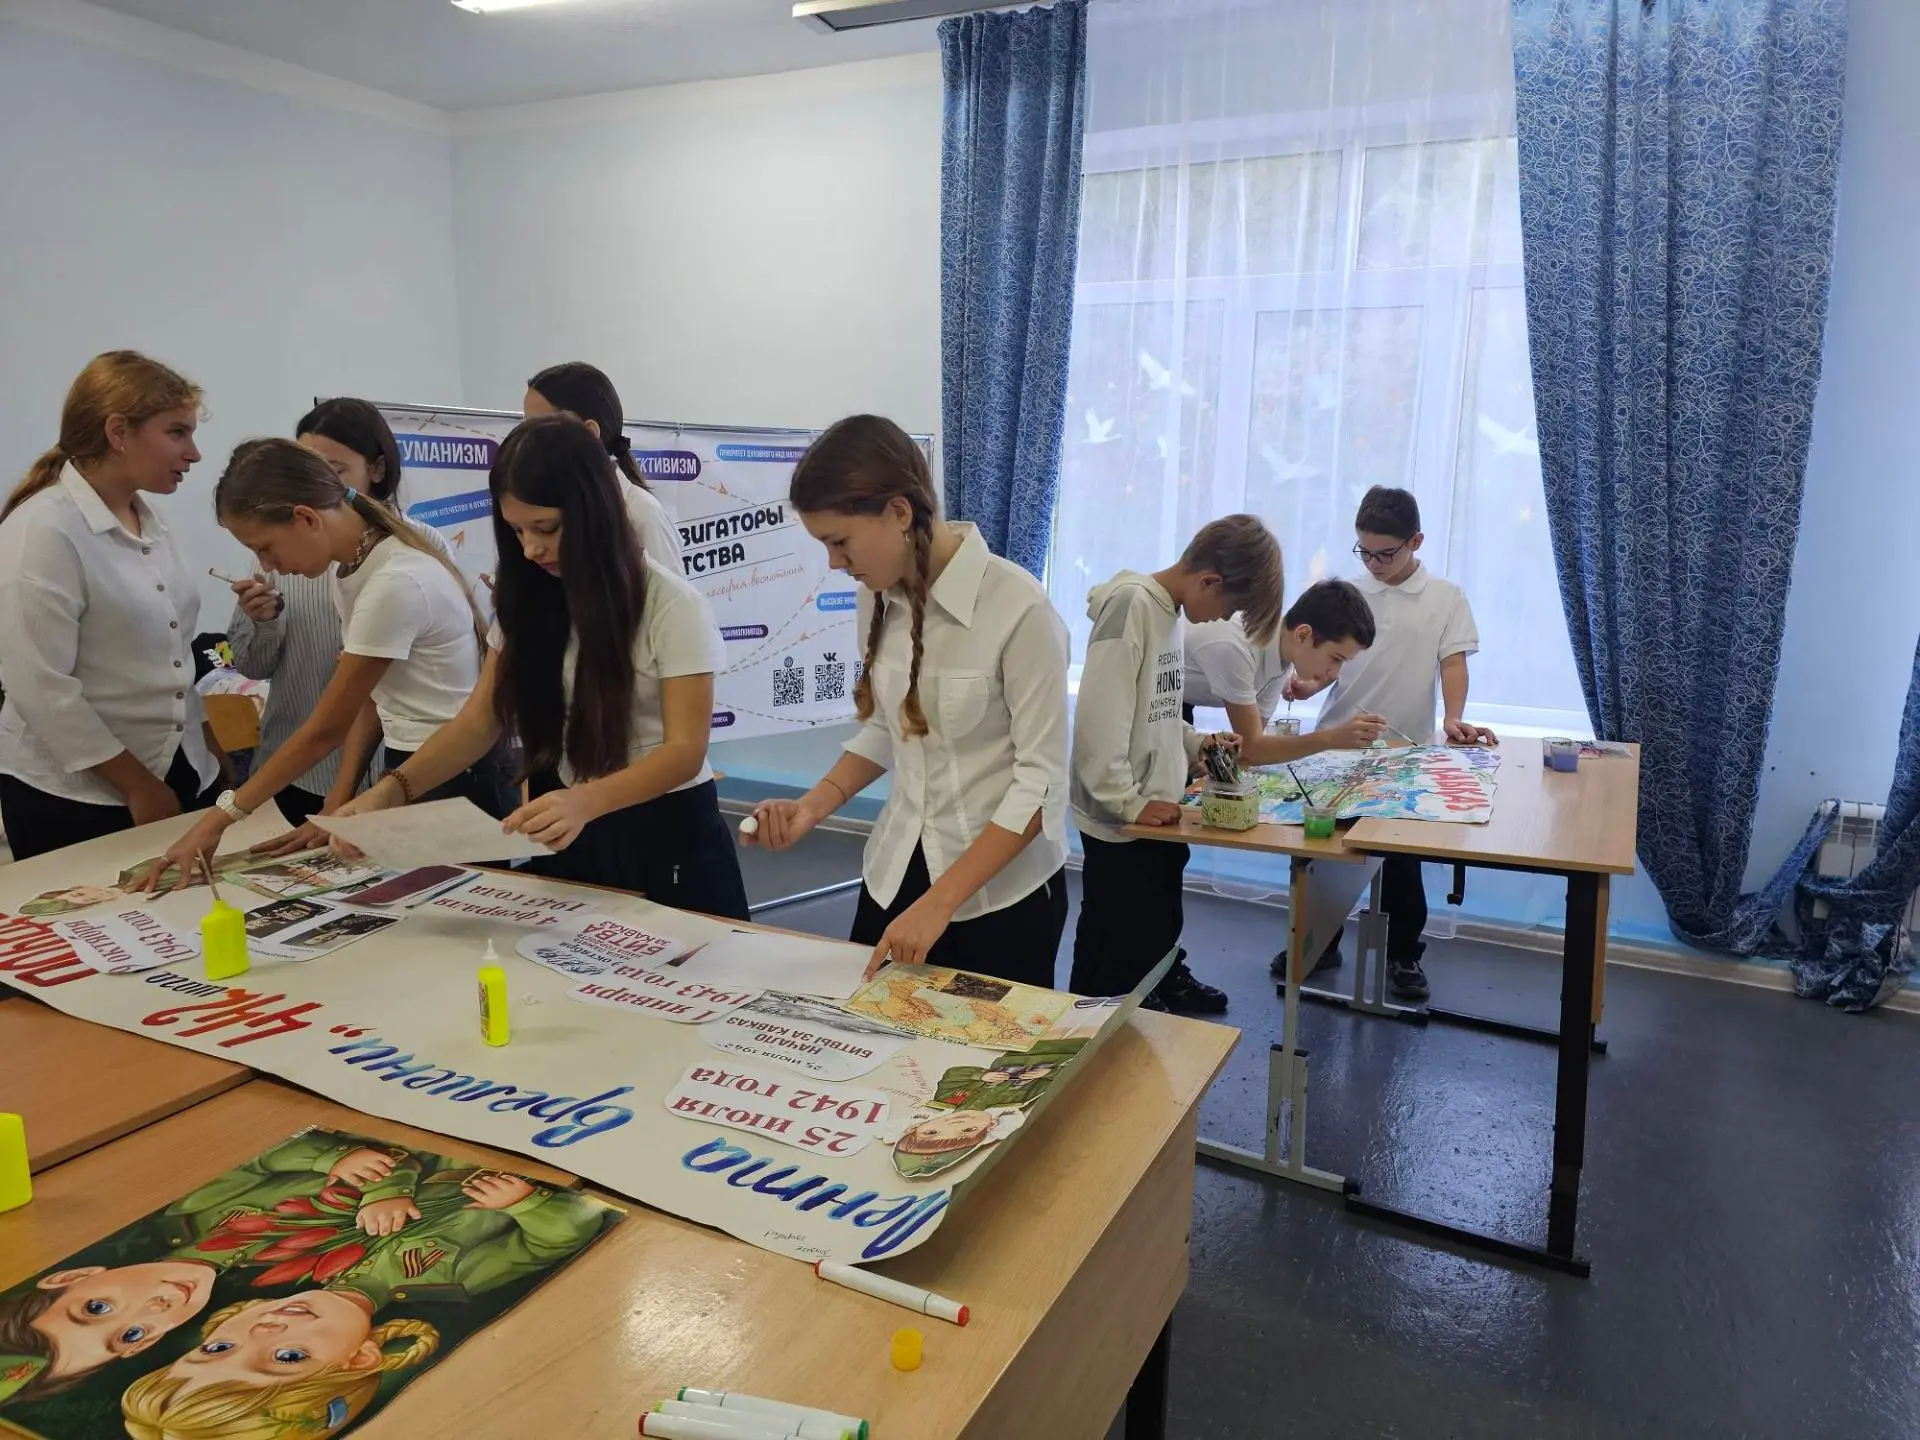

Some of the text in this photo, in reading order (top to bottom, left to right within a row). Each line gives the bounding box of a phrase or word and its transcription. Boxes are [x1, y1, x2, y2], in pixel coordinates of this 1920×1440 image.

[395, 440, 488, 465] УМАНИЗМ
[582, 924, 666, 956] БИТВА
[725, 1016, 791, 1037] КАВКАЗ
[754, 1033, 823, 1056] НАЧАЛО
[815, 1036, 874, 1060] БИТВЫ
[689, 1067, 782, 1098] года
[788, 1089, 886, 1124] 1942
[669, 1095, 858, 1153] 25 июля
